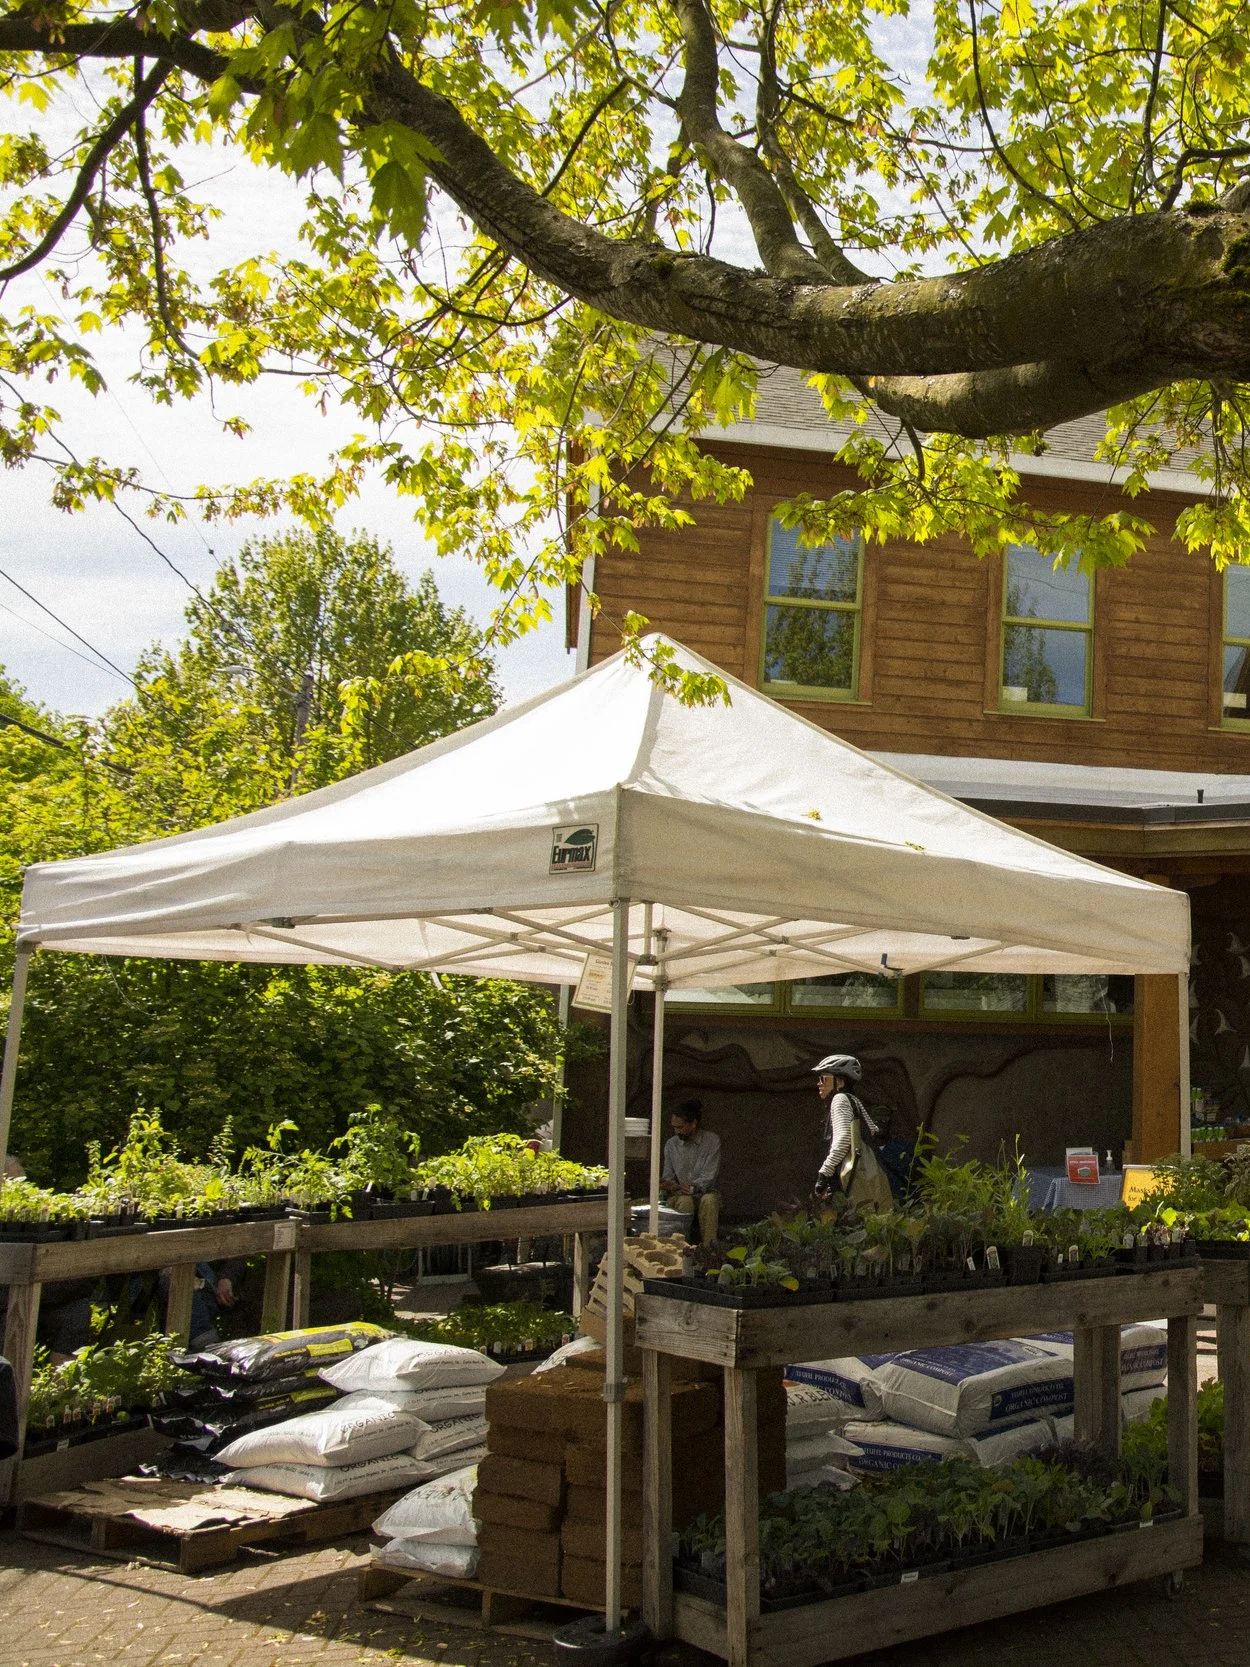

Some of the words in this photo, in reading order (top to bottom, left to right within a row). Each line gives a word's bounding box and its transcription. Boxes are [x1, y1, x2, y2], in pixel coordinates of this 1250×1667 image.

[341, 1411, 396, 1433] ORGANIC
[340, 1455, 399, 1473] ORGANIC
[858, 1457, 891, 1470] ORGANIC
